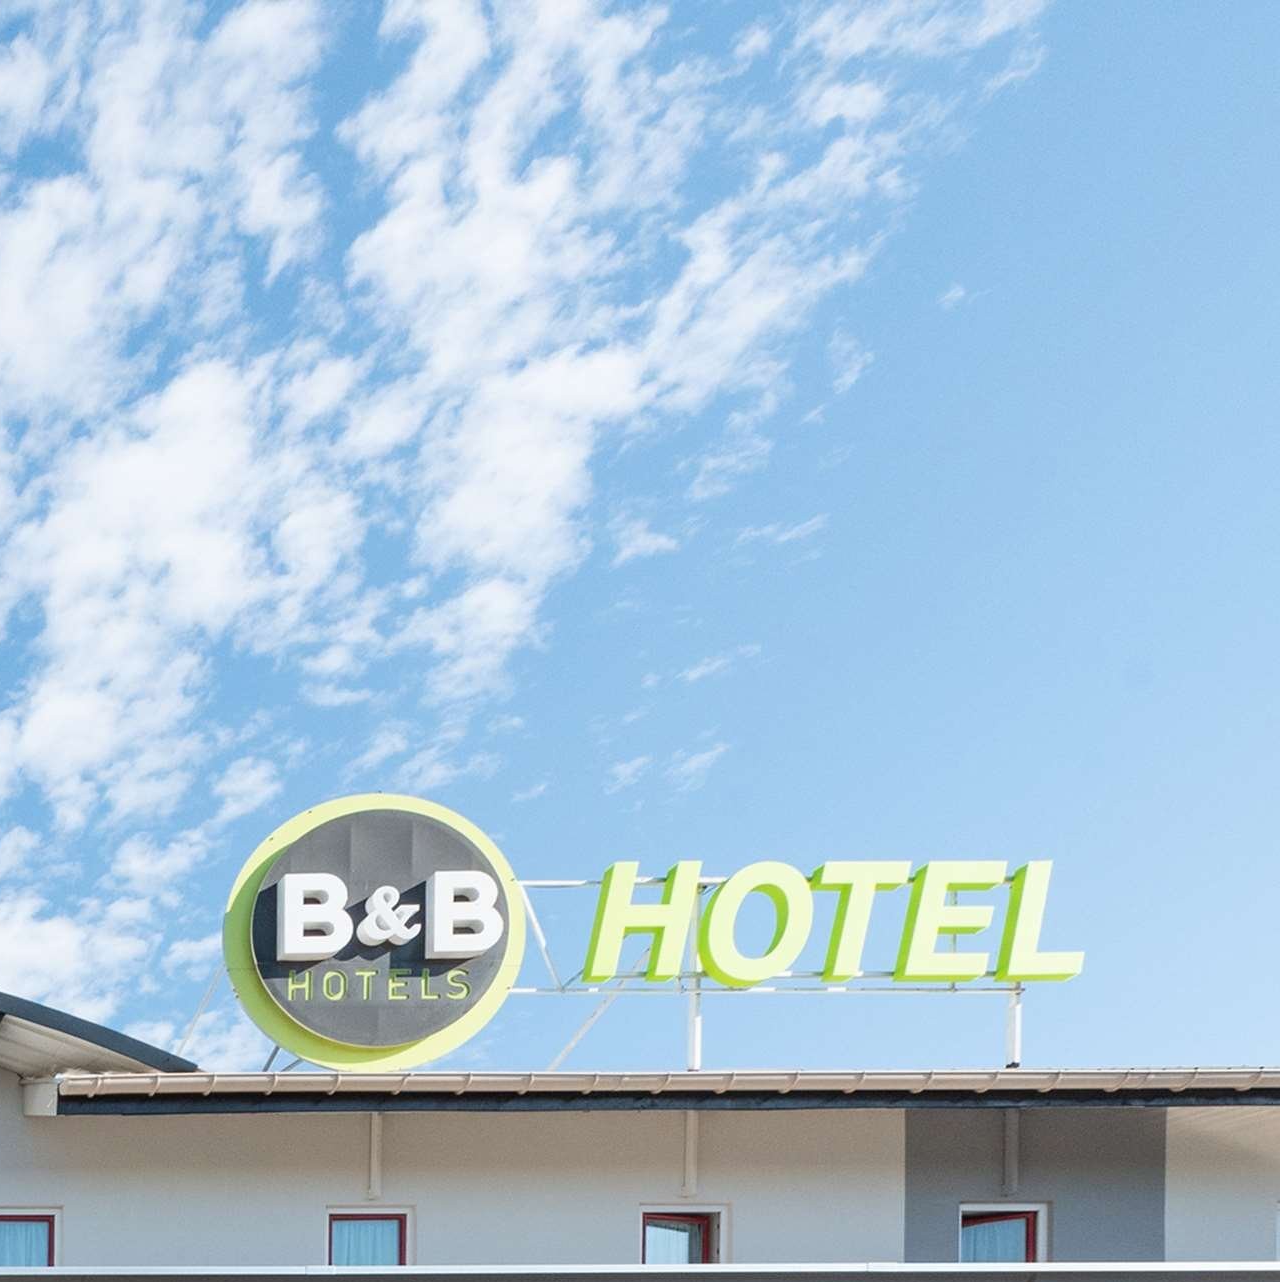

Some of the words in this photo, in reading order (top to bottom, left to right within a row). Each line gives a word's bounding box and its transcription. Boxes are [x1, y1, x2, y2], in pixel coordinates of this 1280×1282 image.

[276, 870, 504, 961] B&B
[581, 859, 1085, 987] HOTEL
[288, 968, 471, 1001] HOTELS
